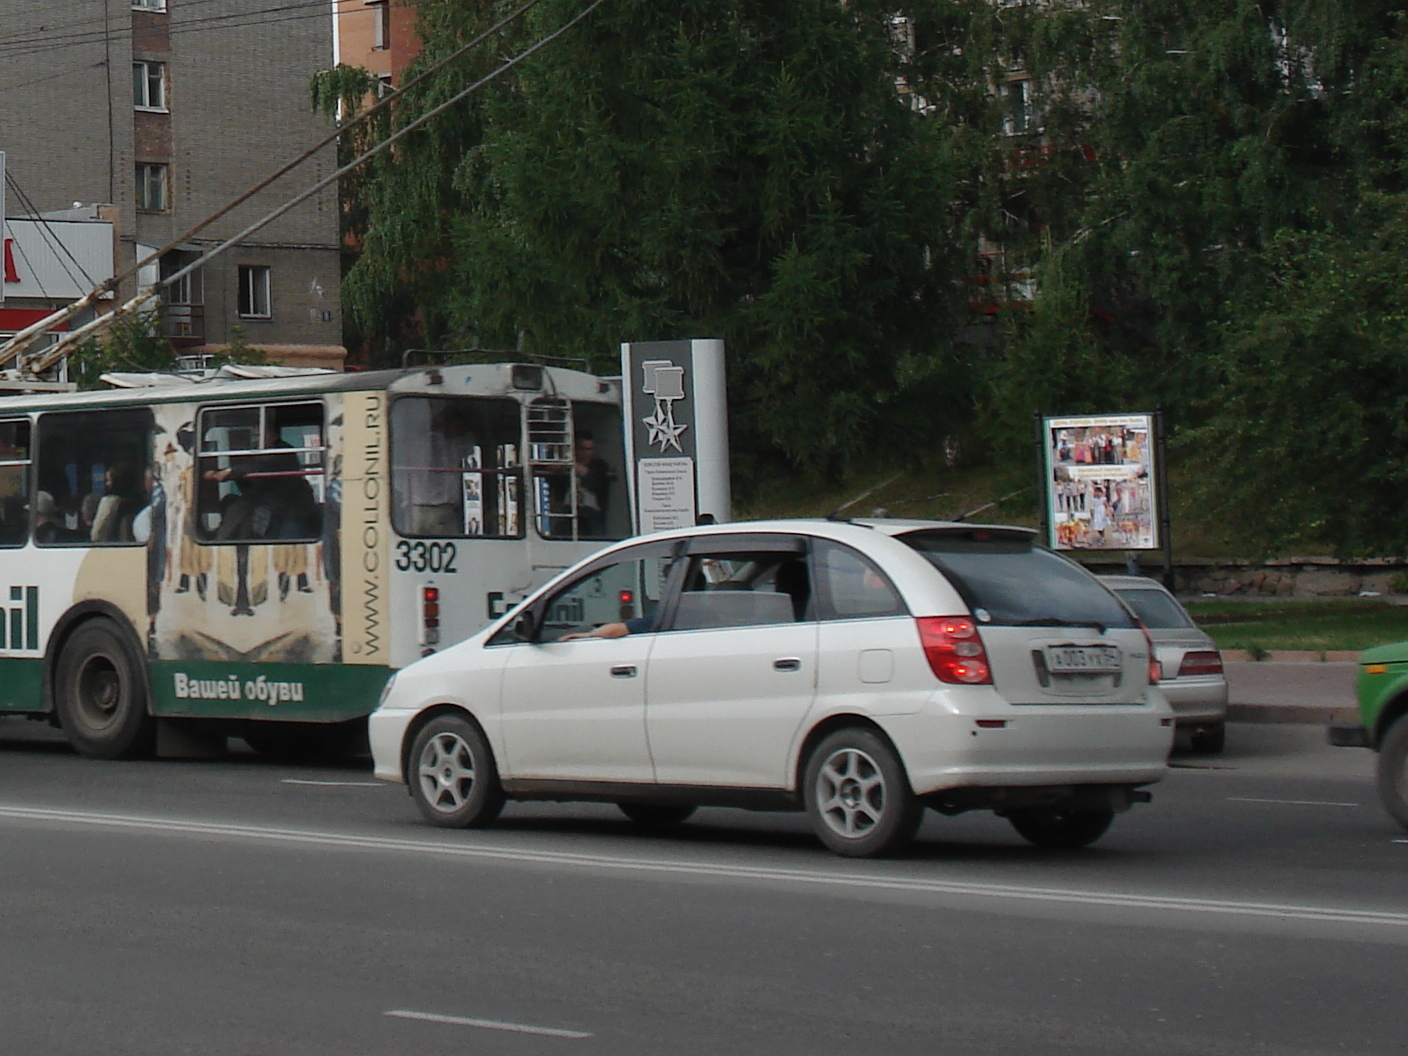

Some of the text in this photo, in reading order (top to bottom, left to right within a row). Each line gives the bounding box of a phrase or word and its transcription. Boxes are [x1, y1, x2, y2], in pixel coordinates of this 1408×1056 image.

[363, 396, 381, 657] WWW.COLLONIL.RU
[396, 541, 458, 574] 3302
[174, 672, 304, 706] Вашей обуви
